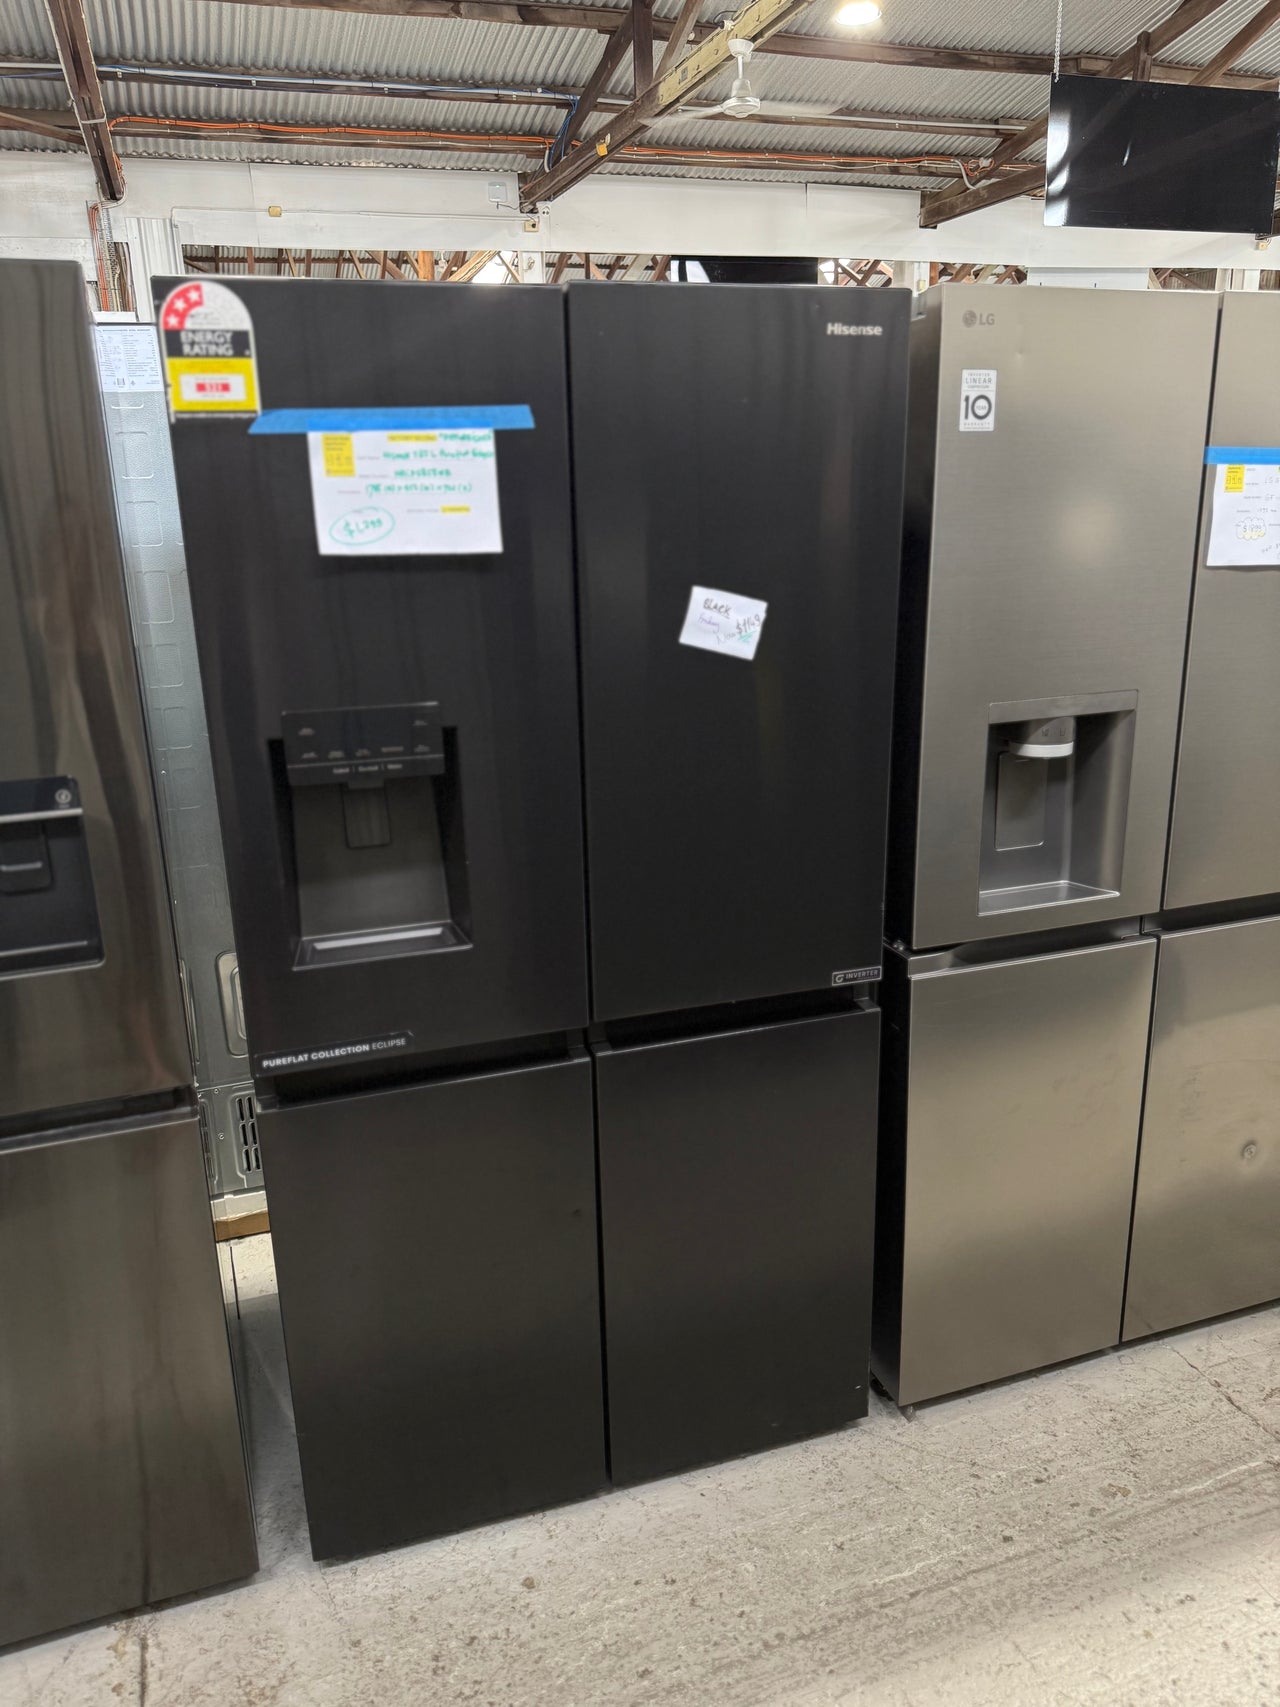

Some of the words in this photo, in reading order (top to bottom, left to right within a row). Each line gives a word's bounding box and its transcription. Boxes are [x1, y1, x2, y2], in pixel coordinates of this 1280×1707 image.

[979, 313, 995, 326] LG
[827, 322, 883, 336] Hisense
[180, 331, 233, 343] ENERGY
[182, 343, 233, 356] RATING
[964, 394, 992, 420] 10
[703, 598, 732, 616] BLACK
[845, 969, 878, 979] INVERTER
[262, 1054, 309, 1068] PUREFLAT
[311, 1044, 370, 1060] COLLECTION
[371, 1038, 406, 1050] ECLIPSE
